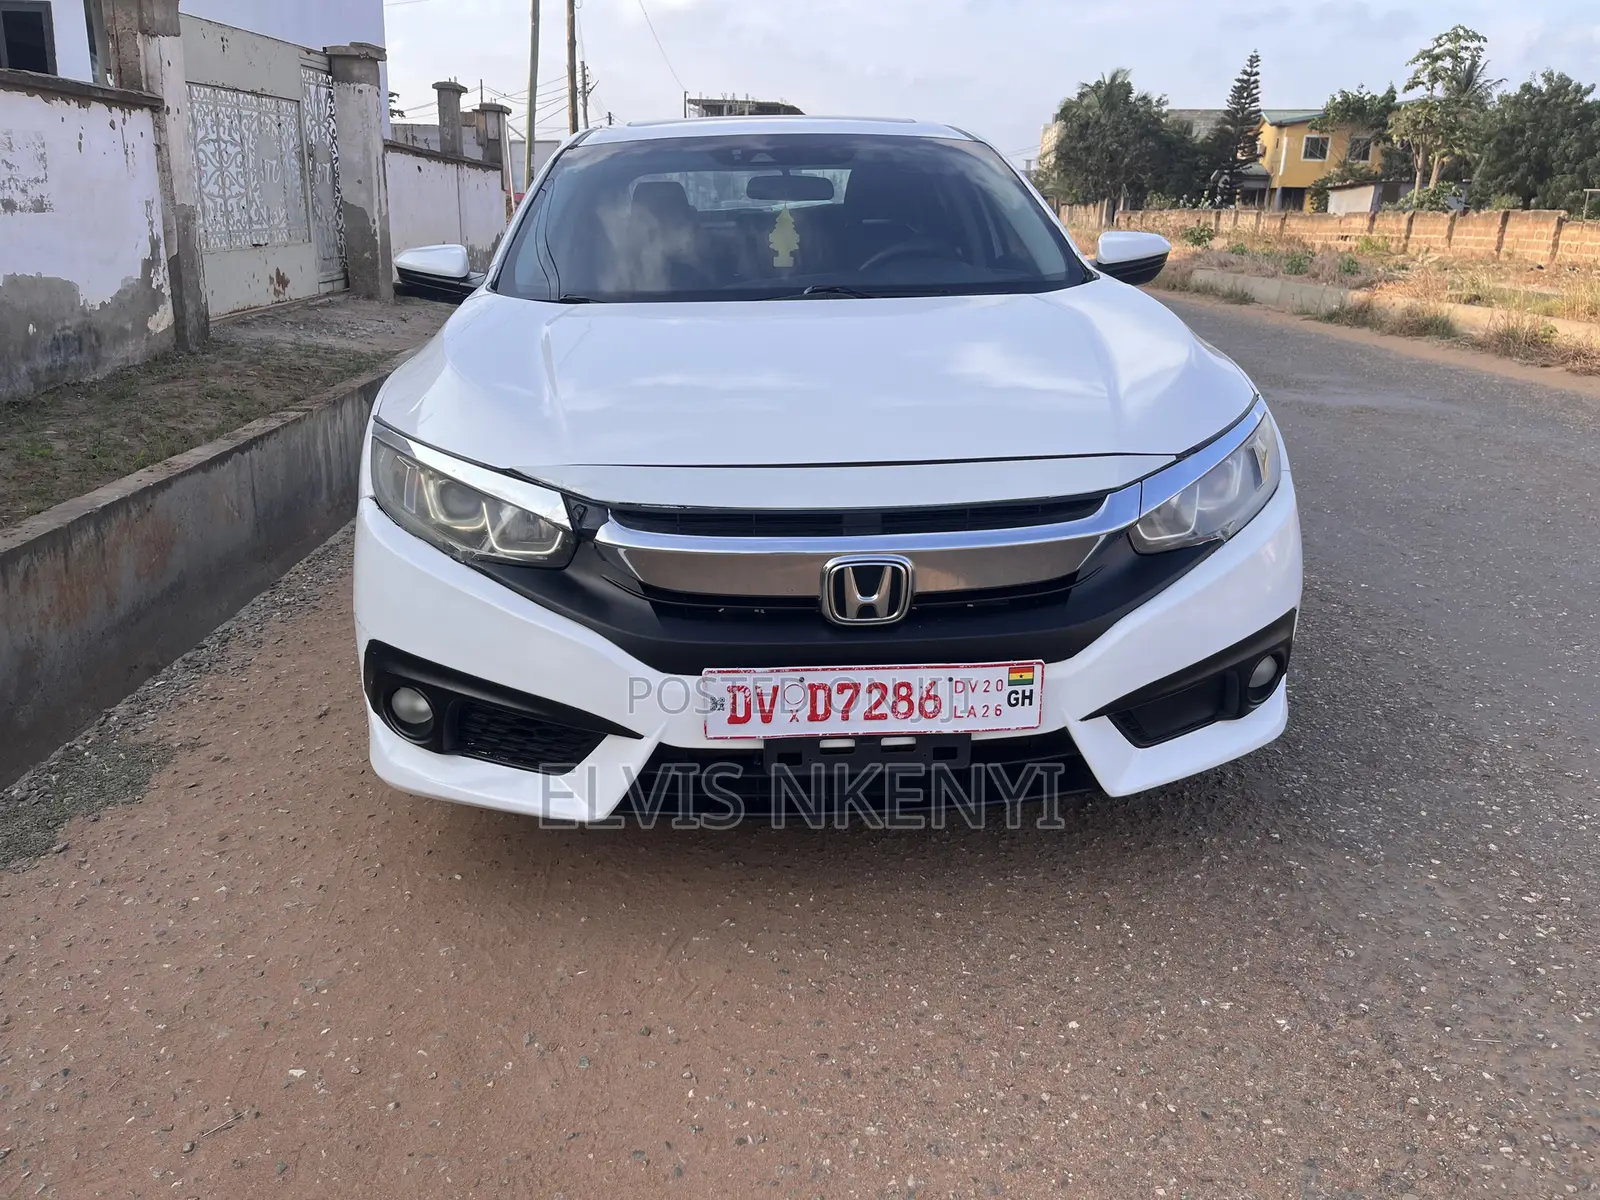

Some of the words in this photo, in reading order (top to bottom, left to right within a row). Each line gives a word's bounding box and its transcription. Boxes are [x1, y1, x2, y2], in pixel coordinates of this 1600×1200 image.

[727, 683, 780, 725] DV
[807, 680, 942, 723] D7286
[1007, 689, 1034, 708] GH
